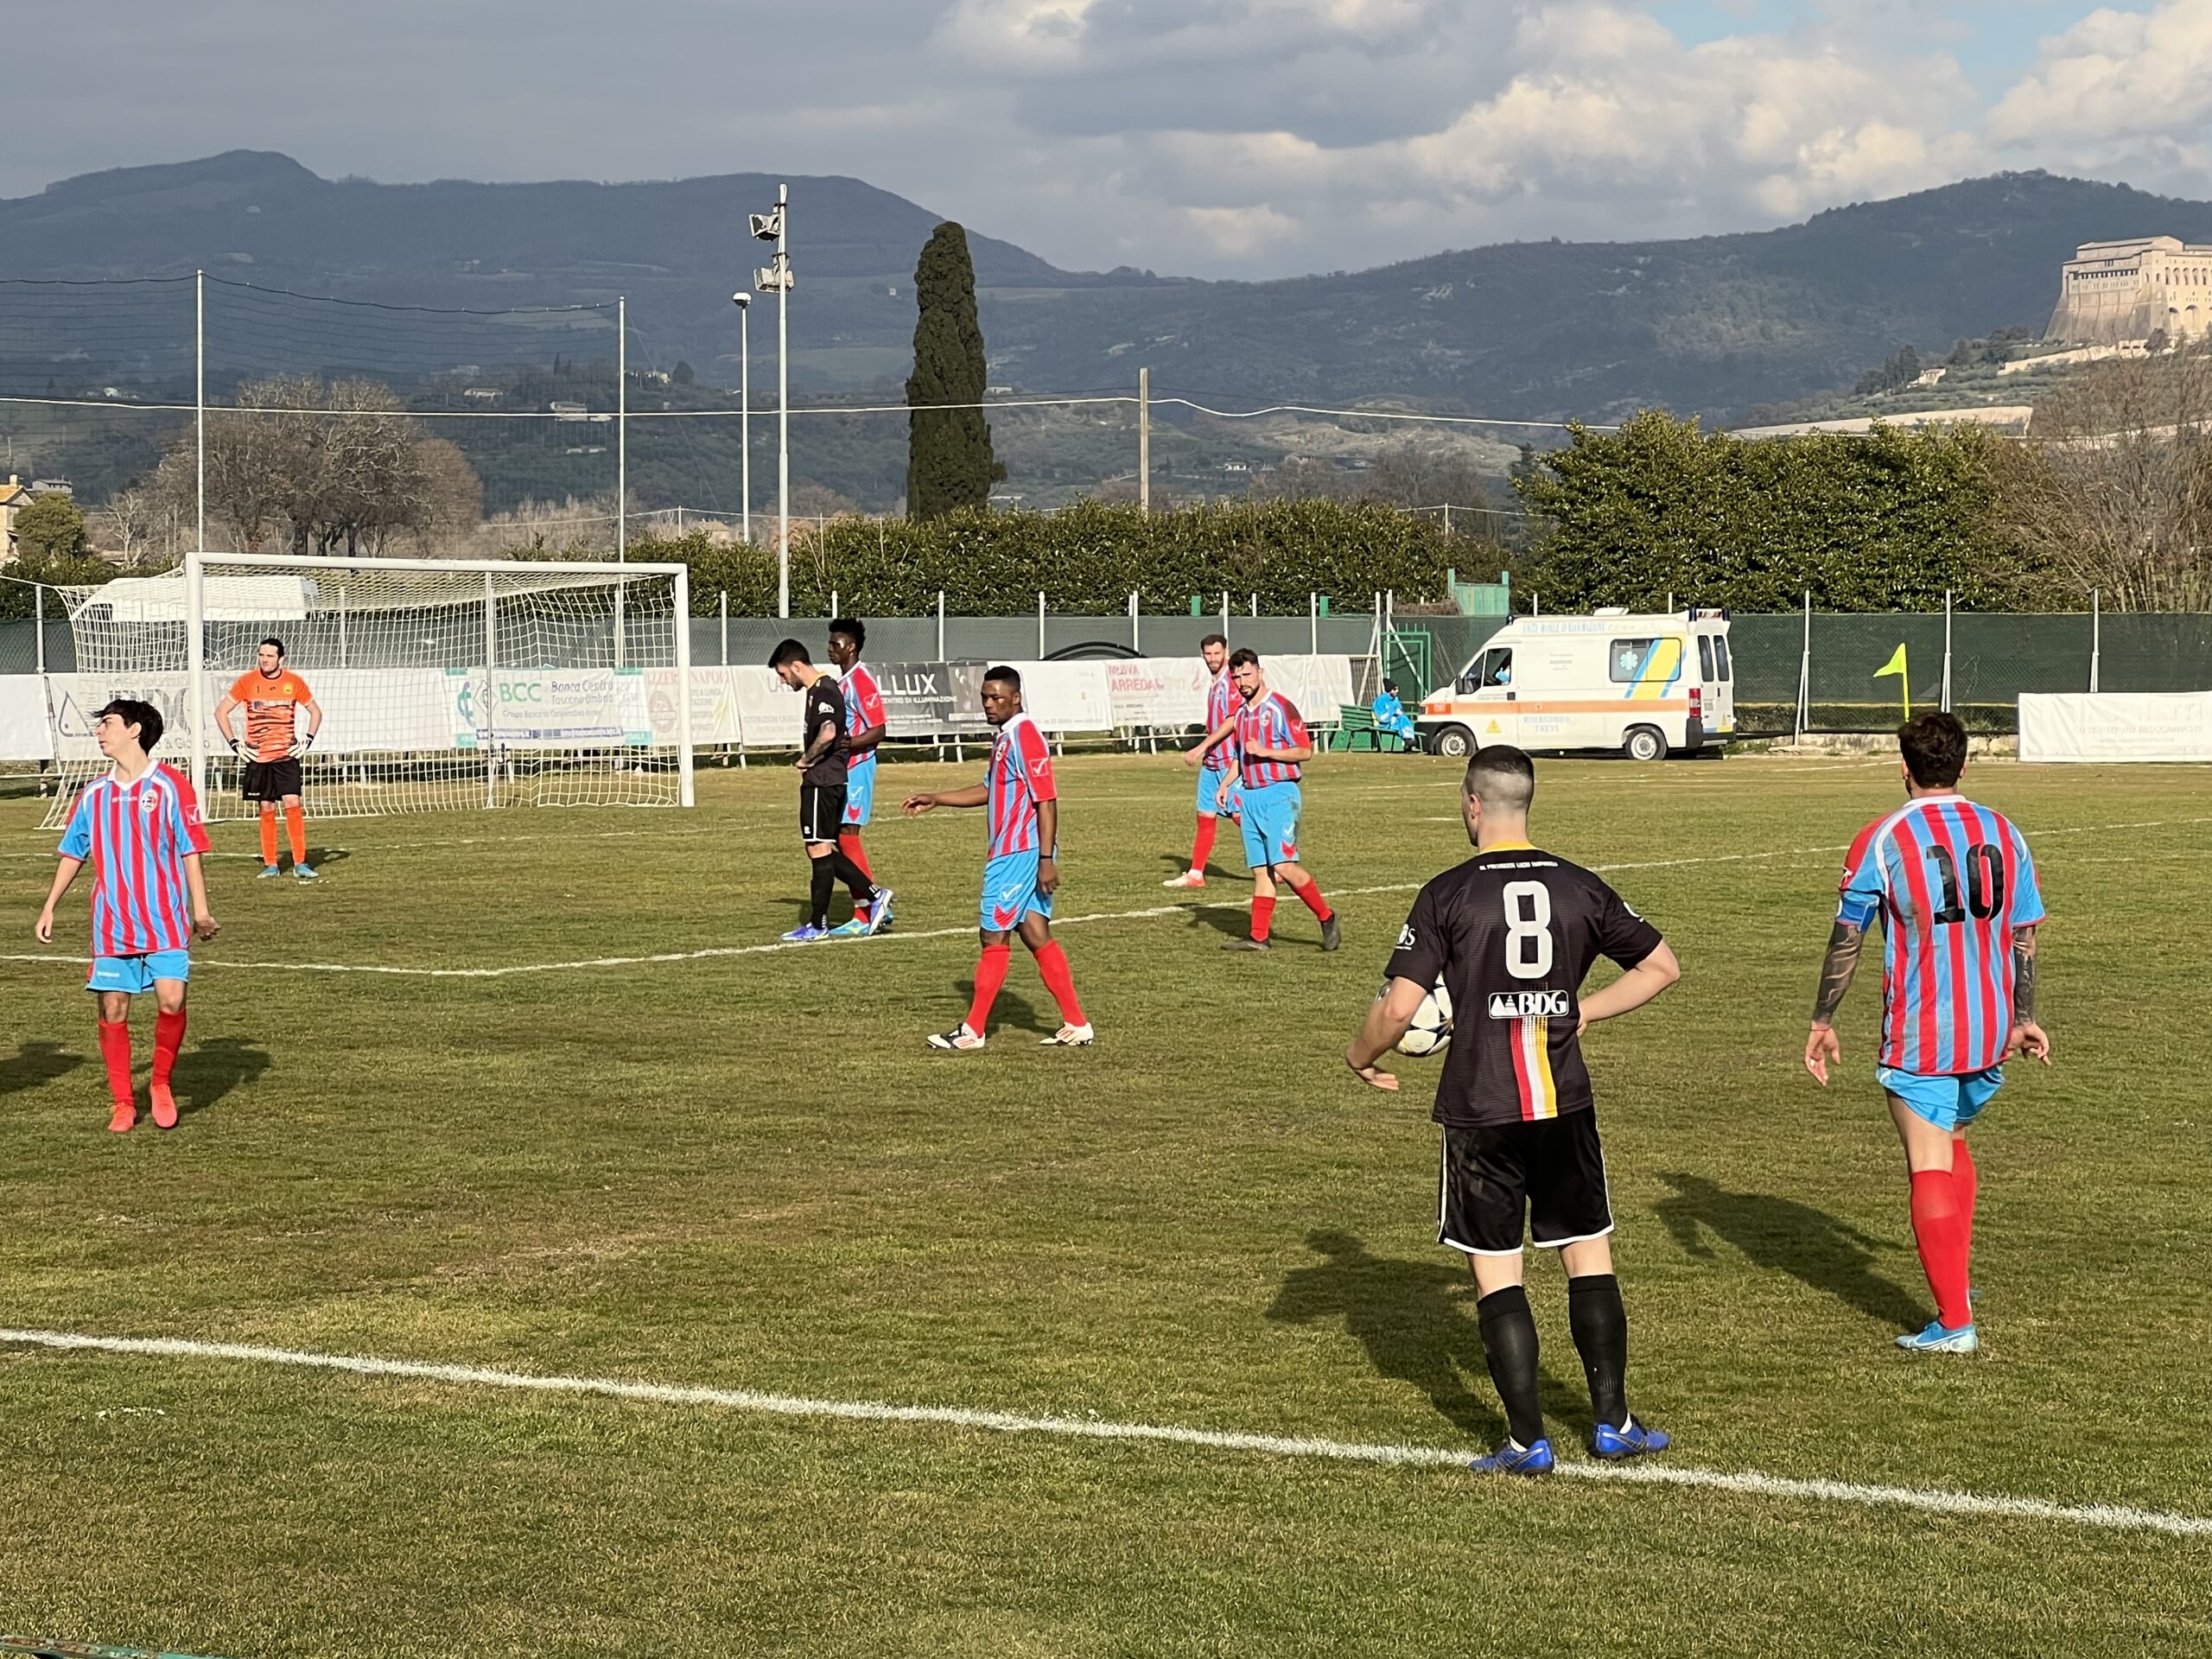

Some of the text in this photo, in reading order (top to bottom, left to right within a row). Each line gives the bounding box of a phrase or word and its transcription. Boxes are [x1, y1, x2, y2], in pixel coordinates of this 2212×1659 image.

[499, 682, 541, 702] BCC
[551, 681, 581, 692] Banca
[1926, 843, 2004, 925] 10
[1503, 880, 1553, 979] 8
[1518, 991, 1567, 1015] BDG
